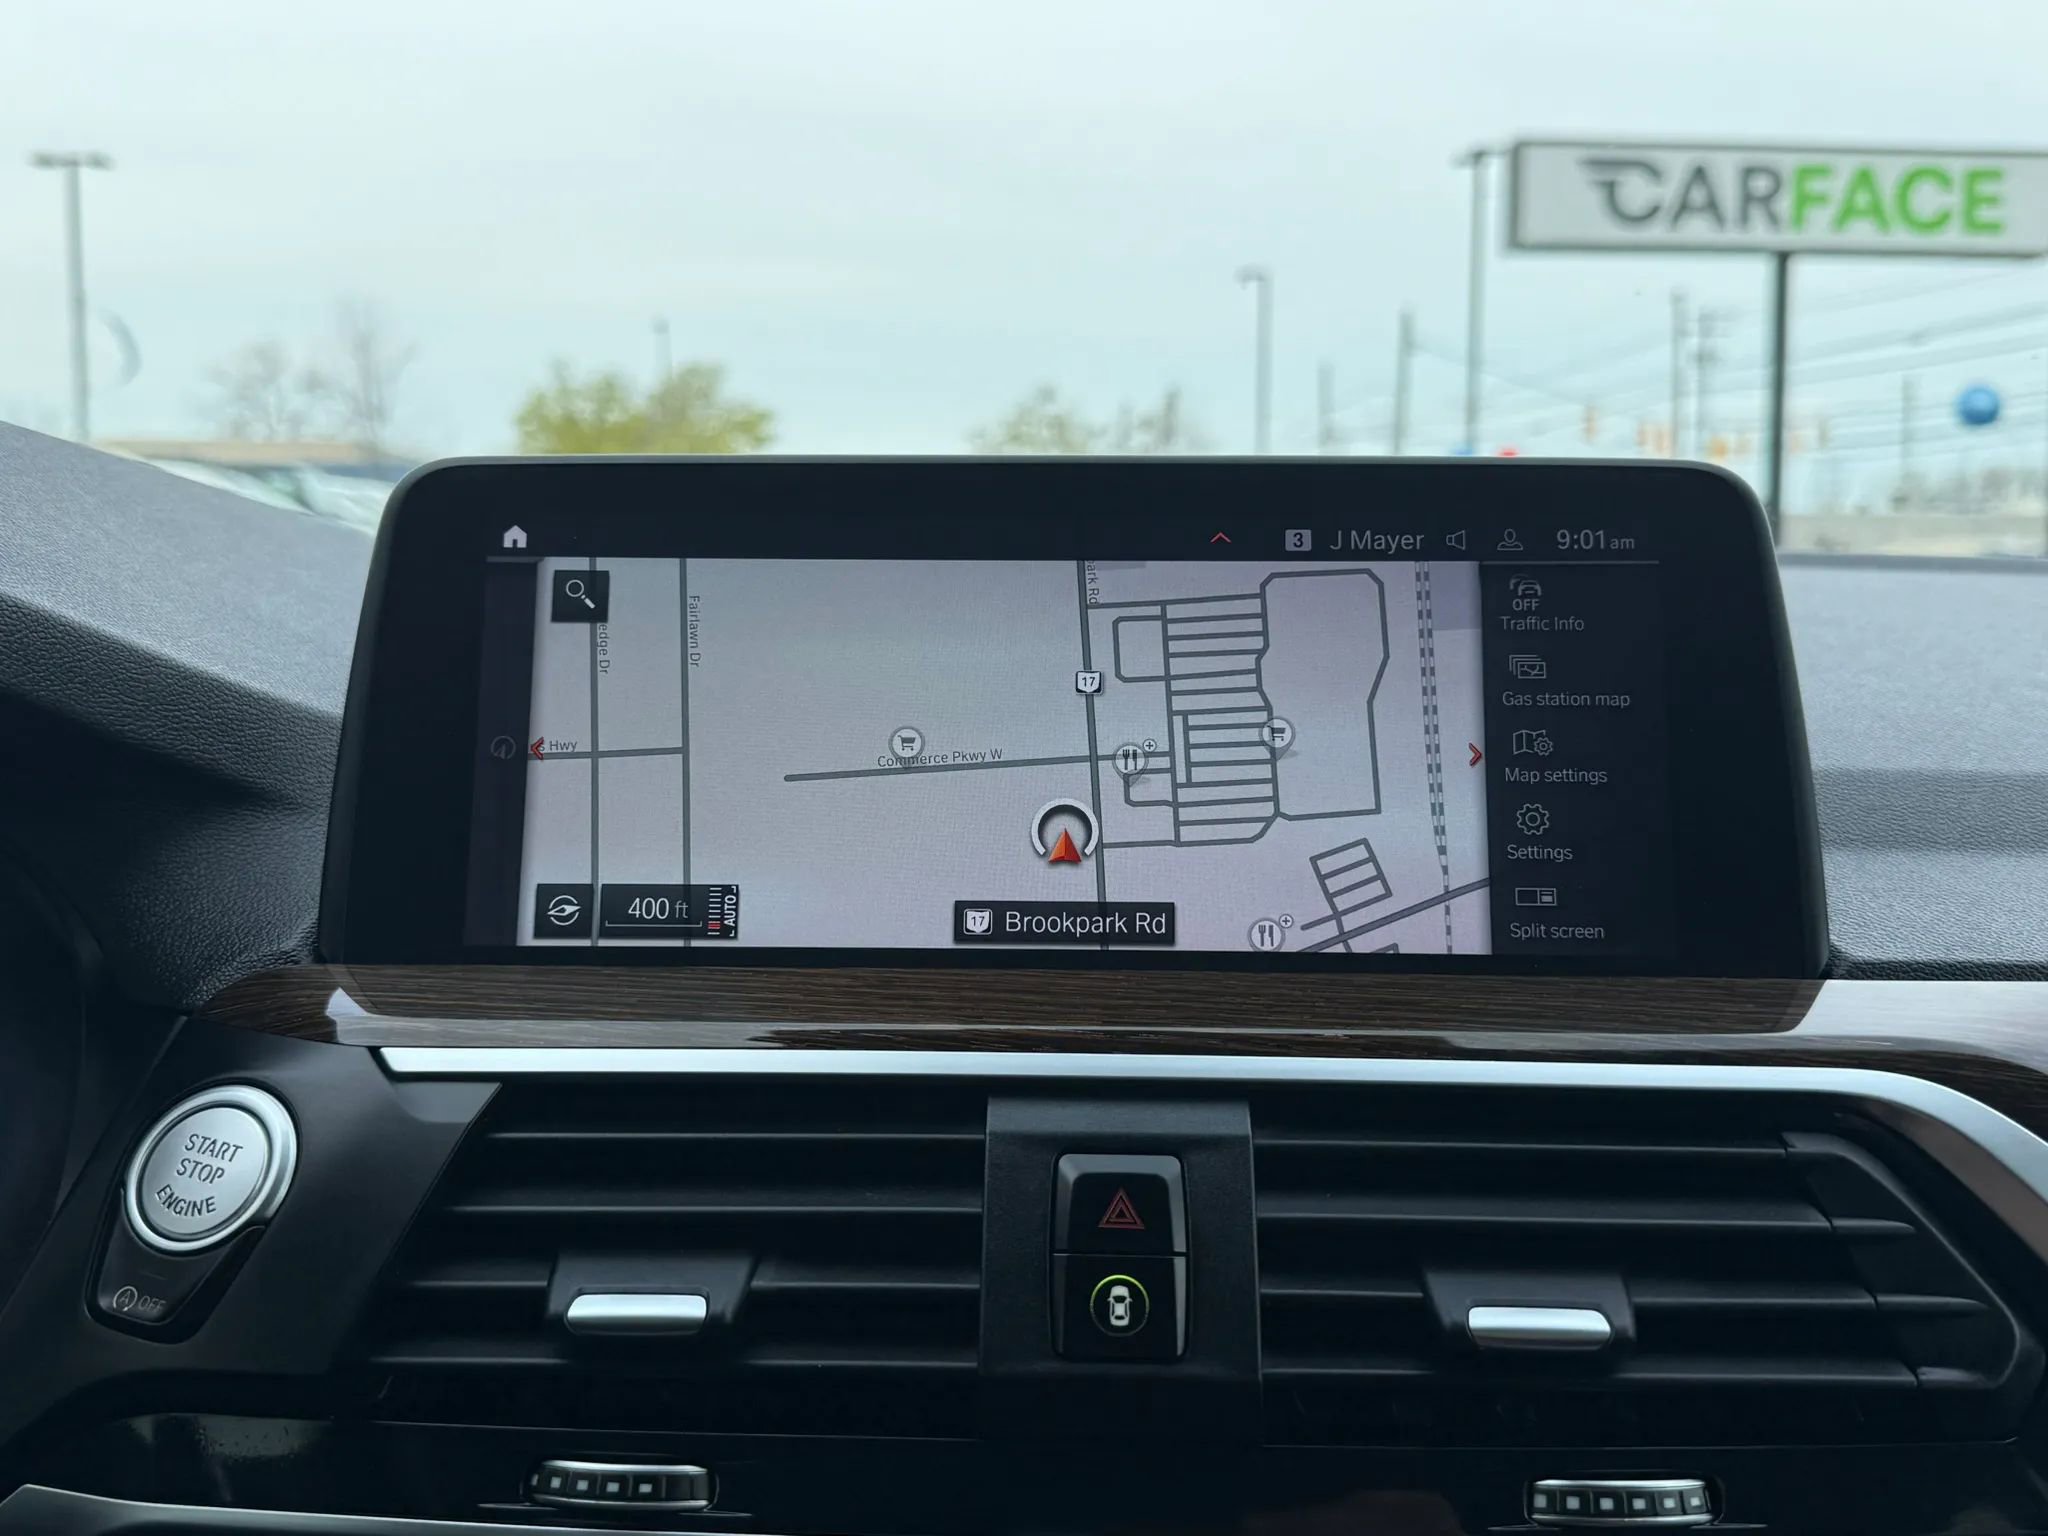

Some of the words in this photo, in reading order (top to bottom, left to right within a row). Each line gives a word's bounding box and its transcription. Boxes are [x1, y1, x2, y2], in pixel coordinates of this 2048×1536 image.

[1578, 157, 2005, 235] CARFACE
[1291, 532, 1304, 548] 3
[1330, 531, 1343, 550] J
[1351, 531, 1425, 554] Mayer
[1085, 560, 1096, 584] ark
[1512, 599, 1540, 611] OFF
[688, 595, 700, 649] Fairlawn
[1500, 616, 1550, 630] Traffic
[1554, 616, 1585, 630] Info
[599, 660, 610, 674] Dr
[689, 653, 701, 667] Dr
[1081, 676, 1096, 687] 17
[1502, 691, 1532, 706] Gas
[1536, 691, 1591, 706] station
[1595, 694, 1630, 709] map
[549, 740, 577, 752] Hwy
[952, 750, 987, 763] Pkwy
[990, 748, 1003, 760] W
[1505, 767, 1540, 784] Map
[1544, 768, 1608, 785] settings
[1507, 844, 1573, 862] Settings
[628, 897, 670, 919] 400
[675, 900, 689, 918] ft
[723, 894, 737, 927] AUTO
[970, 915, 986, 926] 17
[1006, 911, 1128, 938] Brookpark
[1135, 912, 1166, 934] Rd
[1510, 923, 1546, 940] Split
[1551, 925, 1605, 939] screen
[185, 1134, 243, 1162] START
[176, 1157, 226, 1185] STOP
[156, 1183, 217, 1217] ENGINE
[137, 1294, 167, 1313] OFF
